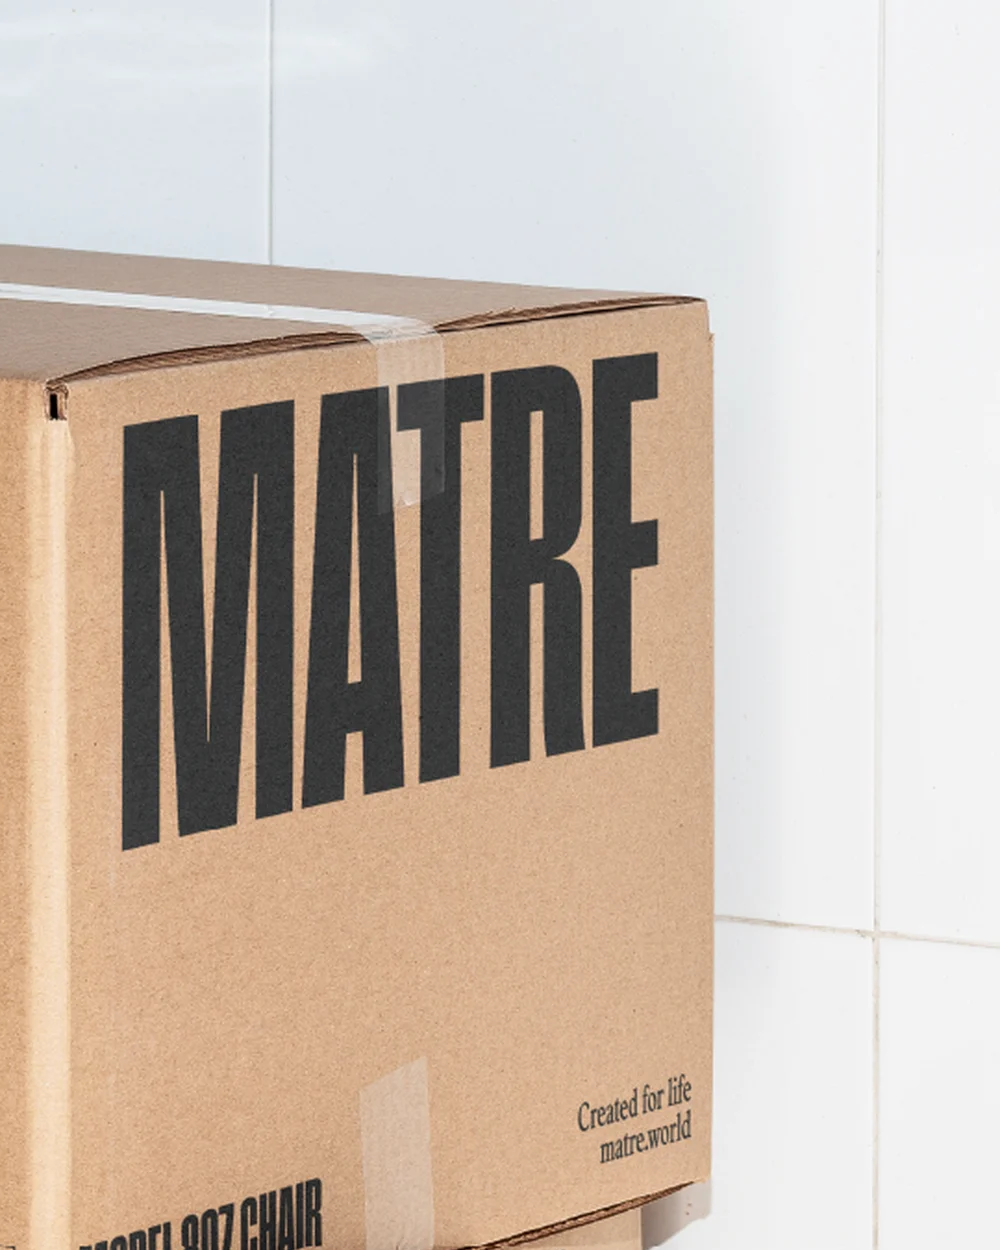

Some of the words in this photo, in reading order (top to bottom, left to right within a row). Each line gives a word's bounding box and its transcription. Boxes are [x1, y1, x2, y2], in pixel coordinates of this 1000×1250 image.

[121, 351, 660, 852] MATRE
[577, 1087, 638, 1132] Created
[642, 1084, 665, 1115] for
[667, 1073, 692, 1107] life
[599, 1109, 692, 1164] matre.world
